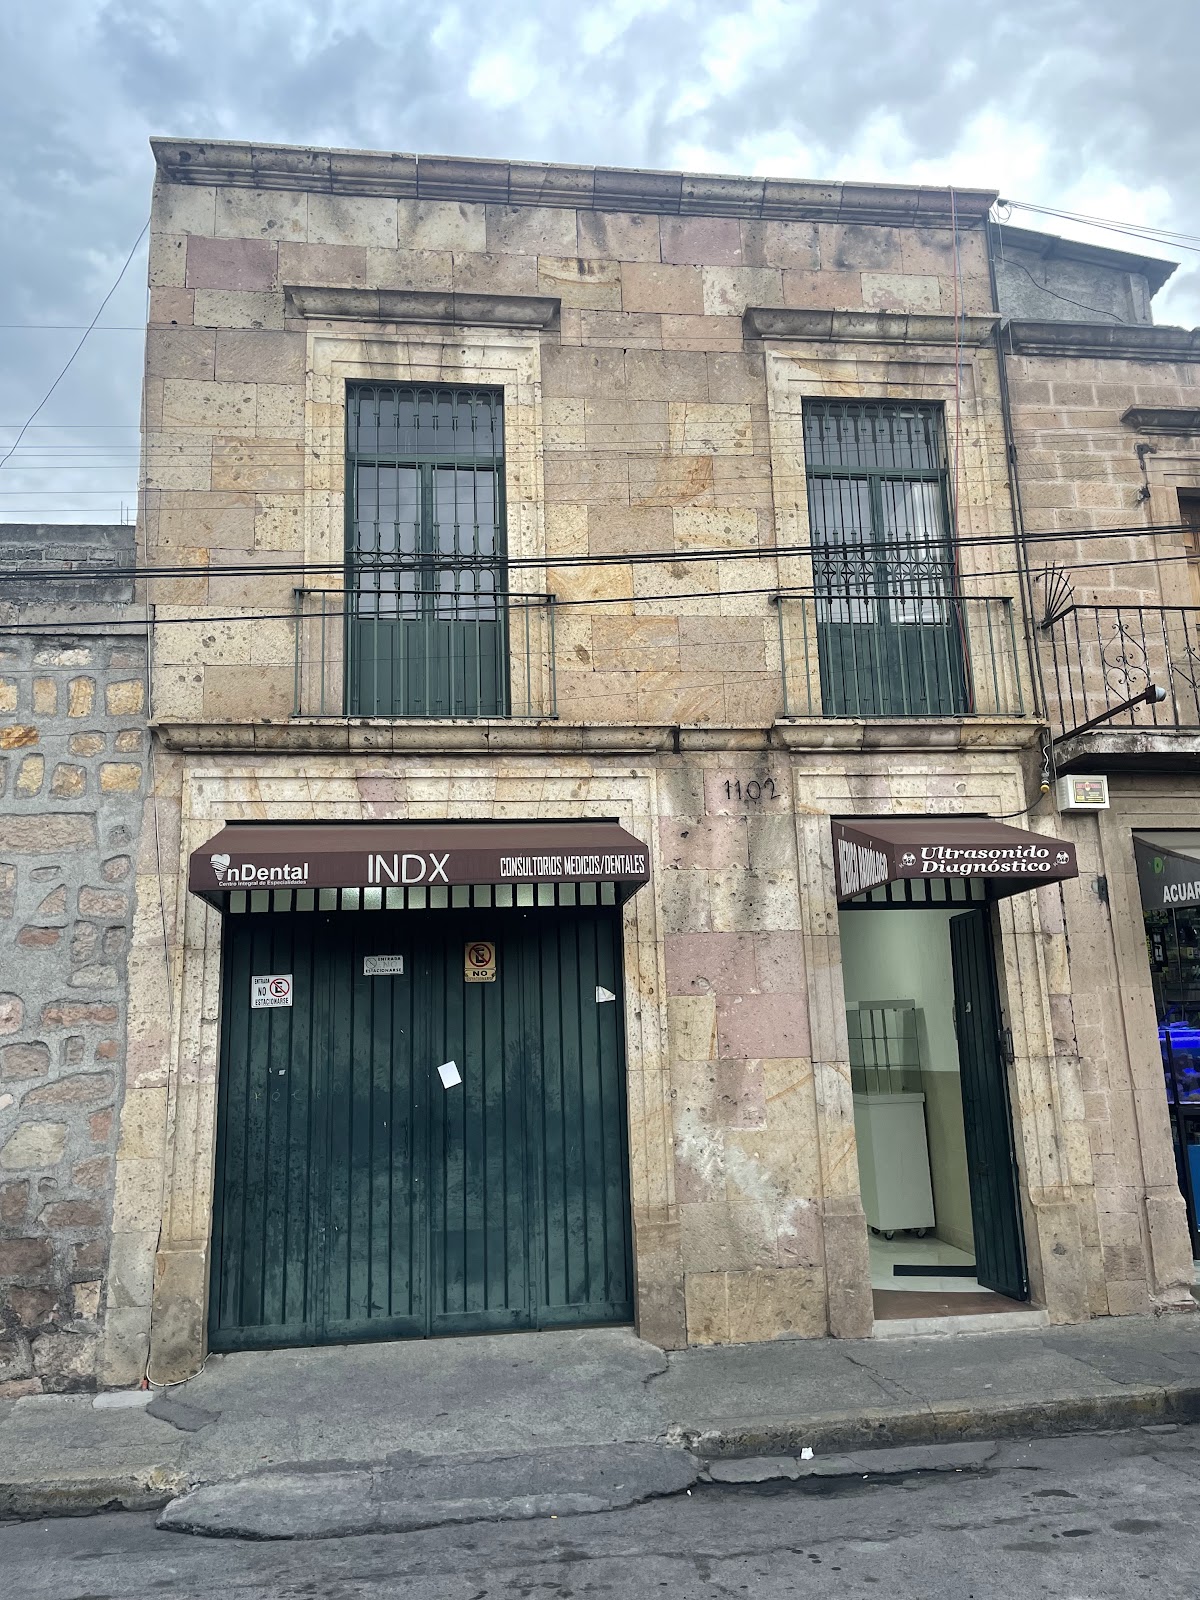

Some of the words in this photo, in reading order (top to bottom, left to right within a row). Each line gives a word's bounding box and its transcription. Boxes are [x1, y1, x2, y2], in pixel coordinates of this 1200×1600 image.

[724, 778, 781, 800] 1102
[921, 845, 1050, 860] Ultrasonido
[368, 853, 450, 884] INDX
[500, 857, 562, 877] CONSULTORIOS
[921, 859, 1051, 875] Diagnóstico
[257, 986, 267, 996] NO
[255, 997, 289, 1005] ESTACIONARSE
